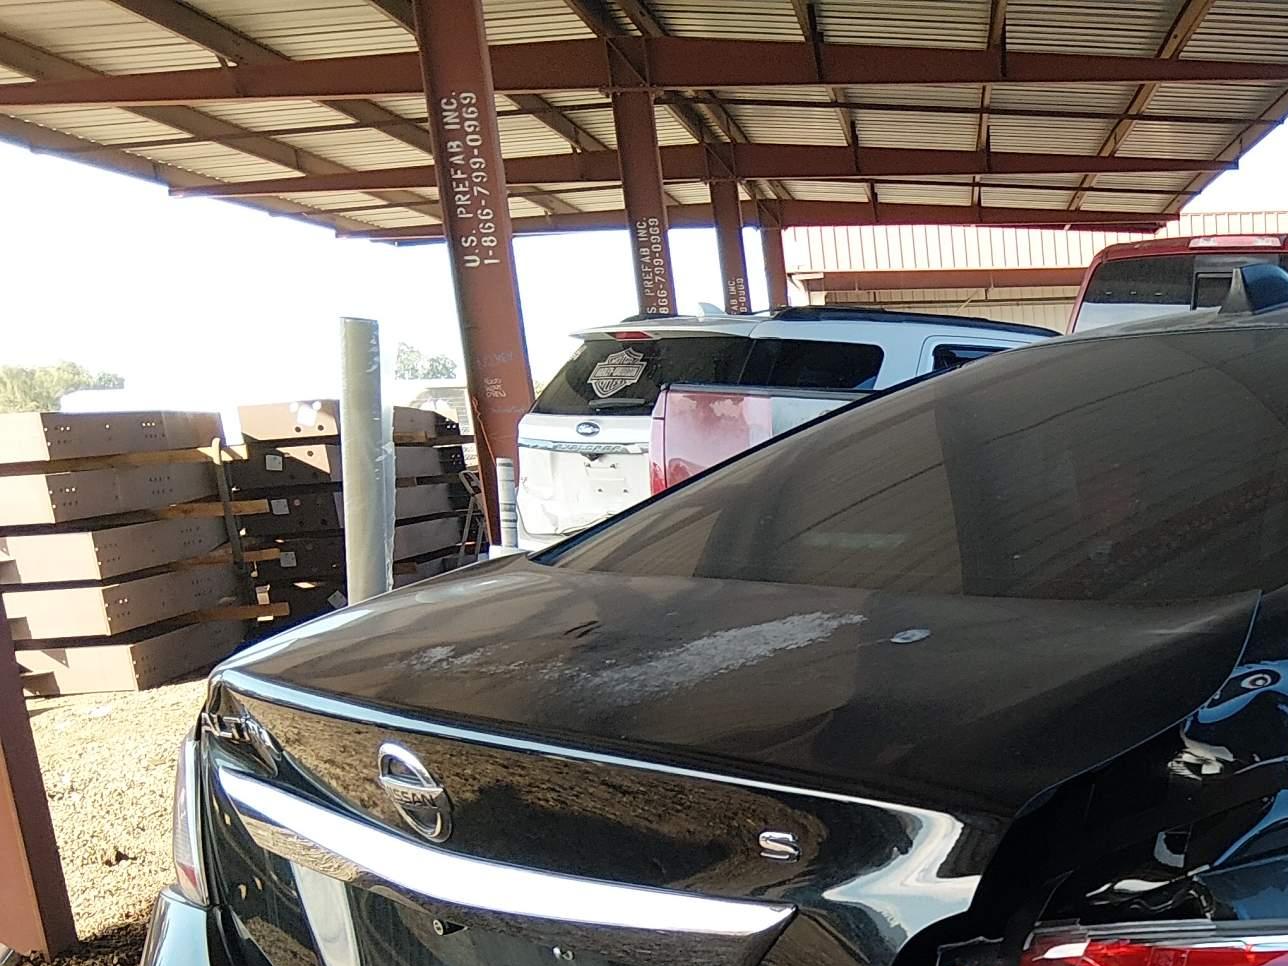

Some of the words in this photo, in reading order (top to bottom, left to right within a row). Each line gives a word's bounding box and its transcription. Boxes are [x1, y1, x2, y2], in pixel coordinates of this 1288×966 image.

[440, 91, 461, 130] INC.
[446, 140, 474, 218] PREFAB
[459, 92, 500, 265] 1-866-799-0969
[461, 230, 481, 267] U.S.
[636, 217, 649, 241] INC.
[640, 248, 655, 296] PREFAB
[648, 218, 670, 314] 866-799-0969
[759, 831, 801, 864] S
